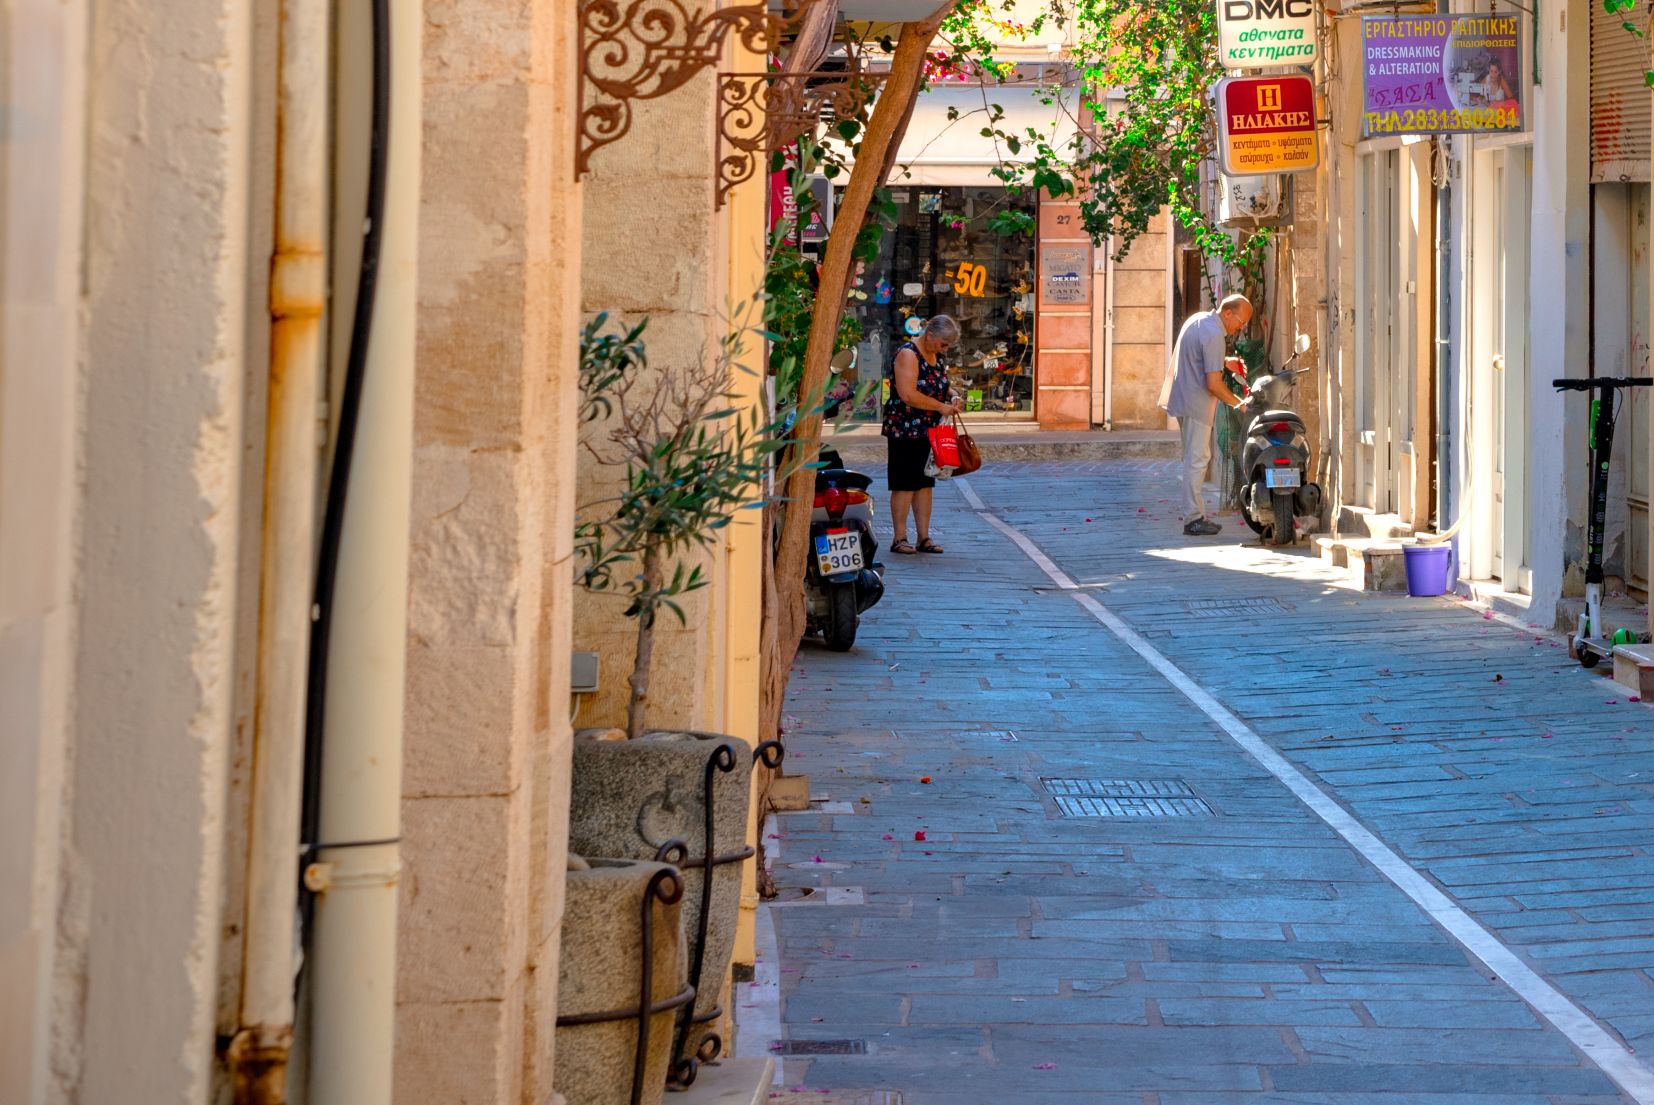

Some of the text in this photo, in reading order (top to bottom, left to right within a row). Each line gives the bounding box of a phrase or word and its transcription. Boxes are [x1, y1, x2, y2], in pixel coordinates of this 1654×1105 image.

[1365, 18, 1516, 39] ΕΡΓΑΣΤΗΡΙΟ ΡΑΠΤΙΚΗΣ
[1228, 43, 1314, 60] κεντηματα
[1367, 45, 1440, 59] DRESSMAKING
[1369, 62, 1440, 75] & ALTERATION
[1231, 111, 1310, 130] ΗΛΙΑΚΗΣ
[1057, 214, 1071, 225] 27
[828, 535, 858, 552] HZP
[831, 552, 861, 569] 306
